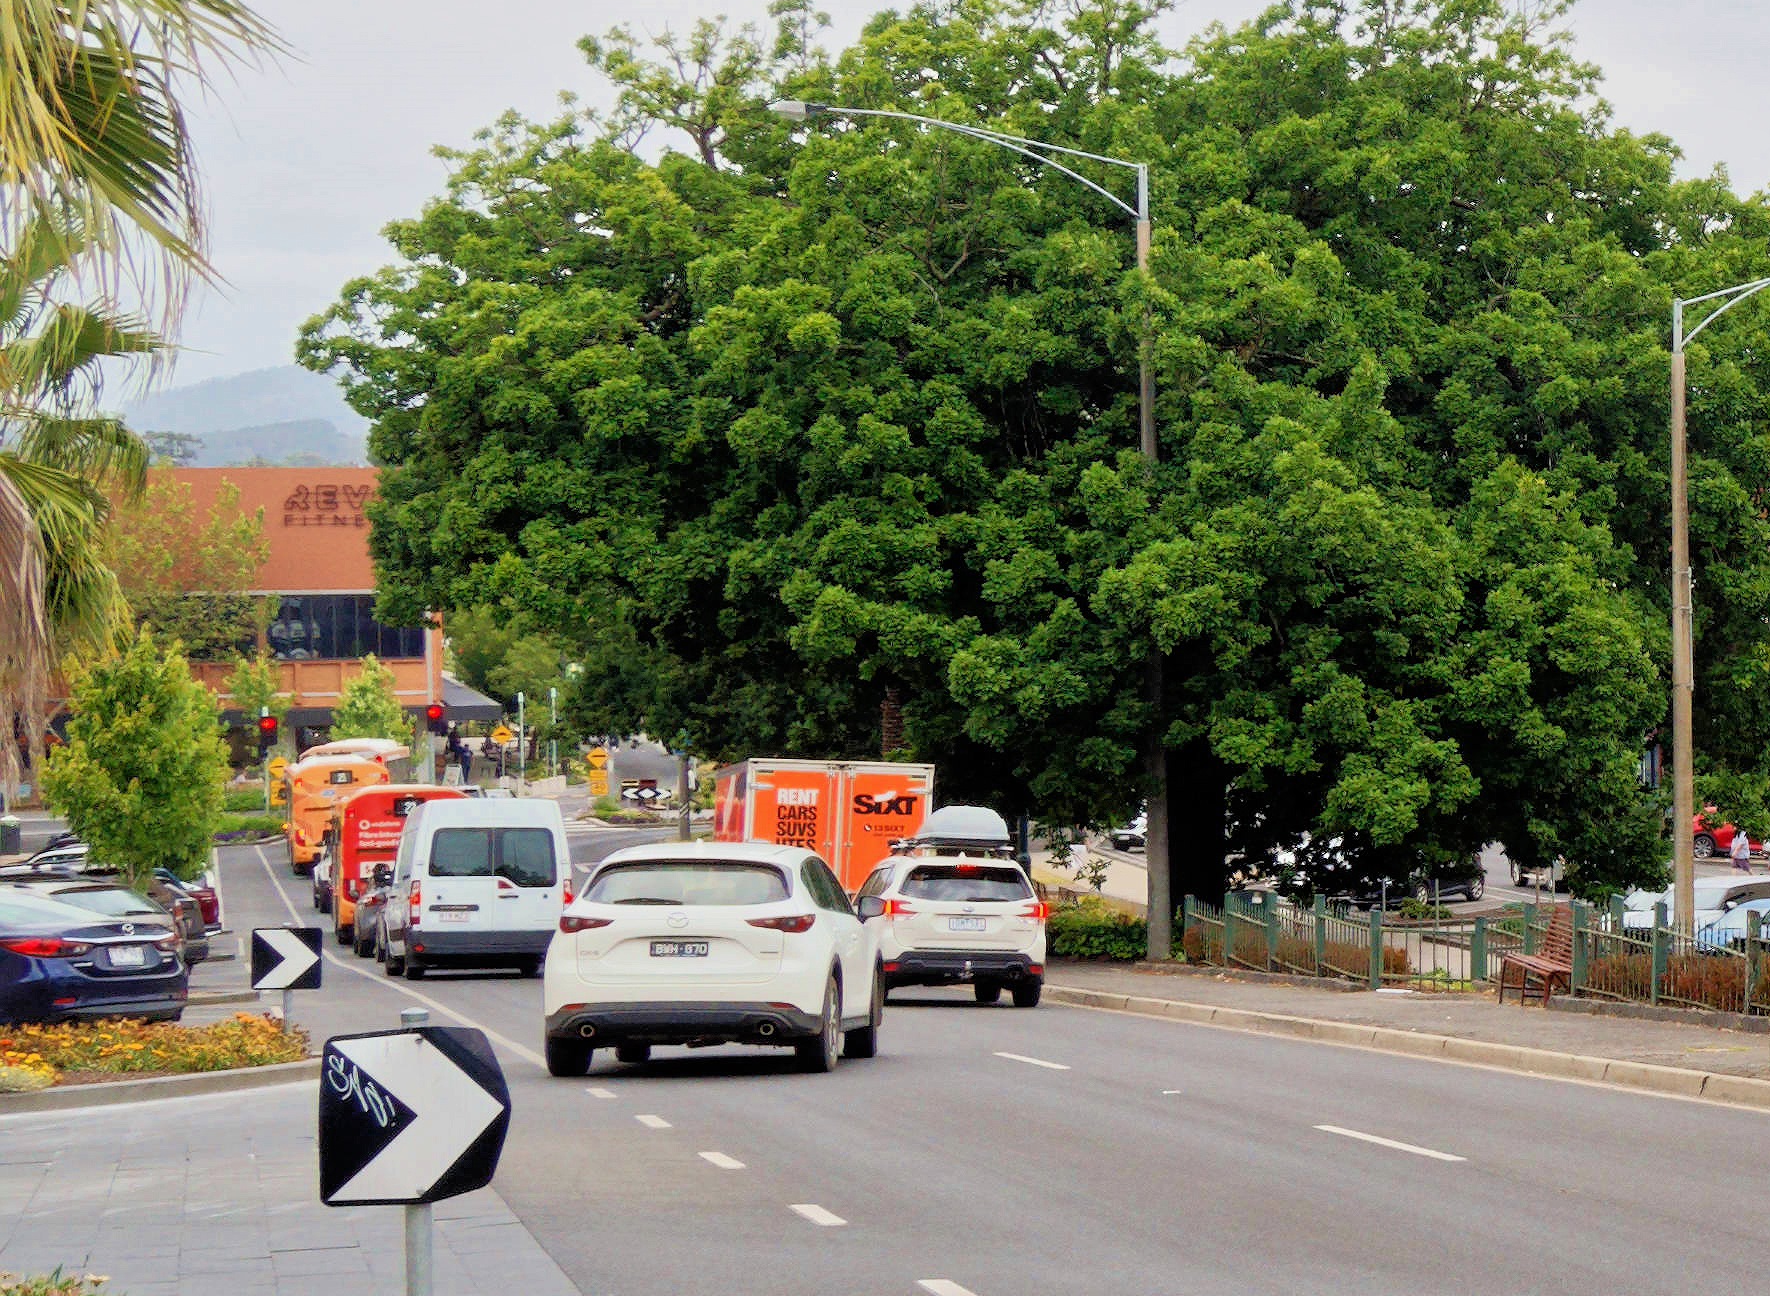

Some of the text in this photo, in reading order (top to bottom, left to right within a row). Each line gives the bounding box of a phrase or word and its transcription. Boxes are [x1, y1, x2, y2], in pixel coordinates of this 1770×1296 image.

[284, 484, 370, 510] REV
[284, 513, 365, 527] FITNE
[777, 788, 820, 805] RENT
[777, 805, 817, 821] CARS
[776, 821, 817, 837] SUVS
